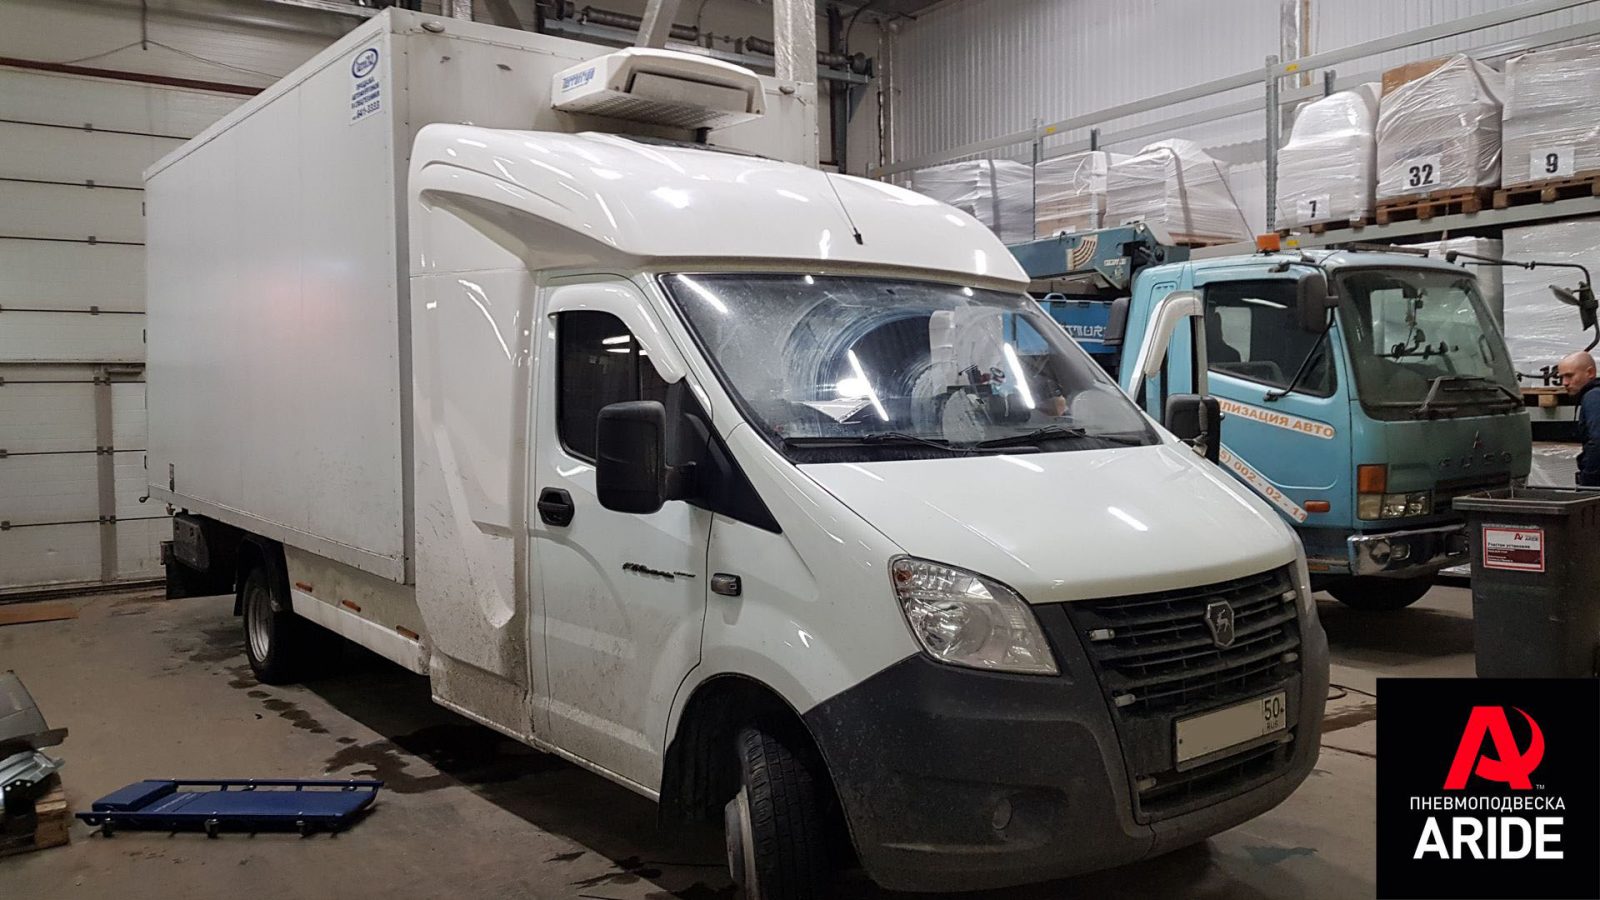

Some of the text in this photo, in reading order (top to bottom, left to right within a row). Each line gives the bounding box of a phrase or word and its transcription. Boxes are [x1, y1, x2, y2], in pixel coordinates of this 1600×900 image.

[1545, 153, 1558, 173] 9
[1409, 164, 1433, 186] 32
[1309, 200, 1317, 218] 7
[1292, 421, 1334, 438] АВТО
[1233, 461, 1257, 483] 002
[1265, 486, 1281, 503] 02
[1264, 697, 1280, 721] 50
